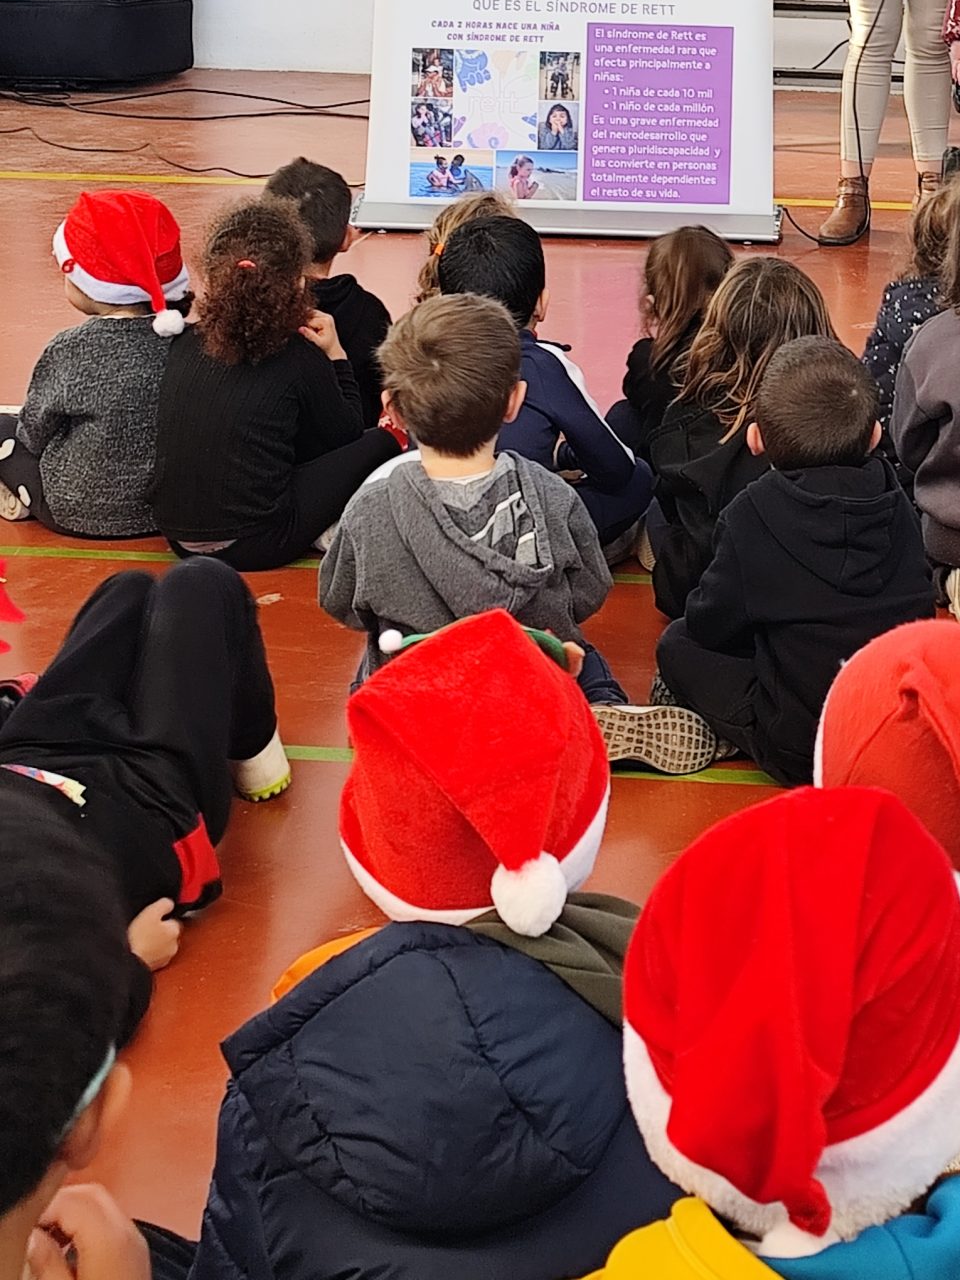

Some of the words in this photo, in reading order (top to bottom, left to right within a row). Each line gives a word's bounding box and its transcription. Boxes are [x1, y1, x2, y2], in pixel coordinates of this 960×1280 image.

[505, 0, 521, 11] ES
[526, 1, 542, 12] EL
[621, 3, 637, 15] DE
[643, 4, 676, 16] RETT
[595, 28, 604, 38] El
[656, 30, 669, 40] de
[671, 30, 693, 41] Rett
[595, 44, 613, 53] una
[615, 44, 675, 54] enfermedad
[677, 46, 697, 55] rara
[699, 47, 717, 56] que
[594, 58, 627, 67] afecta
[629, 59, 703, 70] principalmente
[643, 88, 655, 97] de
[657, 88, 680, 98] cada
[682, 88, 695, 98] 10
[697, 89, 712, 98] mil
[643, 102, 656, 111] de
[658, 102, 680, 112] cada
[593, 115, 604, 124] Es
[610, 116, 628, 125] una
[630, 117, 657, 127] grave
[659, 116, 719, 128] enfermedad
[592, 129, 607, 138] del
[610, 130, 688, 141] neurodesarrollo
[690, 134, 707, 143] que
[592, 145, 626, 155] genera
[628, 144, 710, 156] pluridiscapacidad
[714, 148, 721, 158] y
[592, 158, 606, 168] las
[608, 159, 655, 169] convierte
[673, 161, 717, 171] personas
[591, 173, 649, 183] totalmente
[651, 174, 716, 185] dependientes
[591, 187, 600, 196] el
[602, 188, 629, 197] resto
[631, 188, 643, 197] de
[646, 190, 656, 198] su
